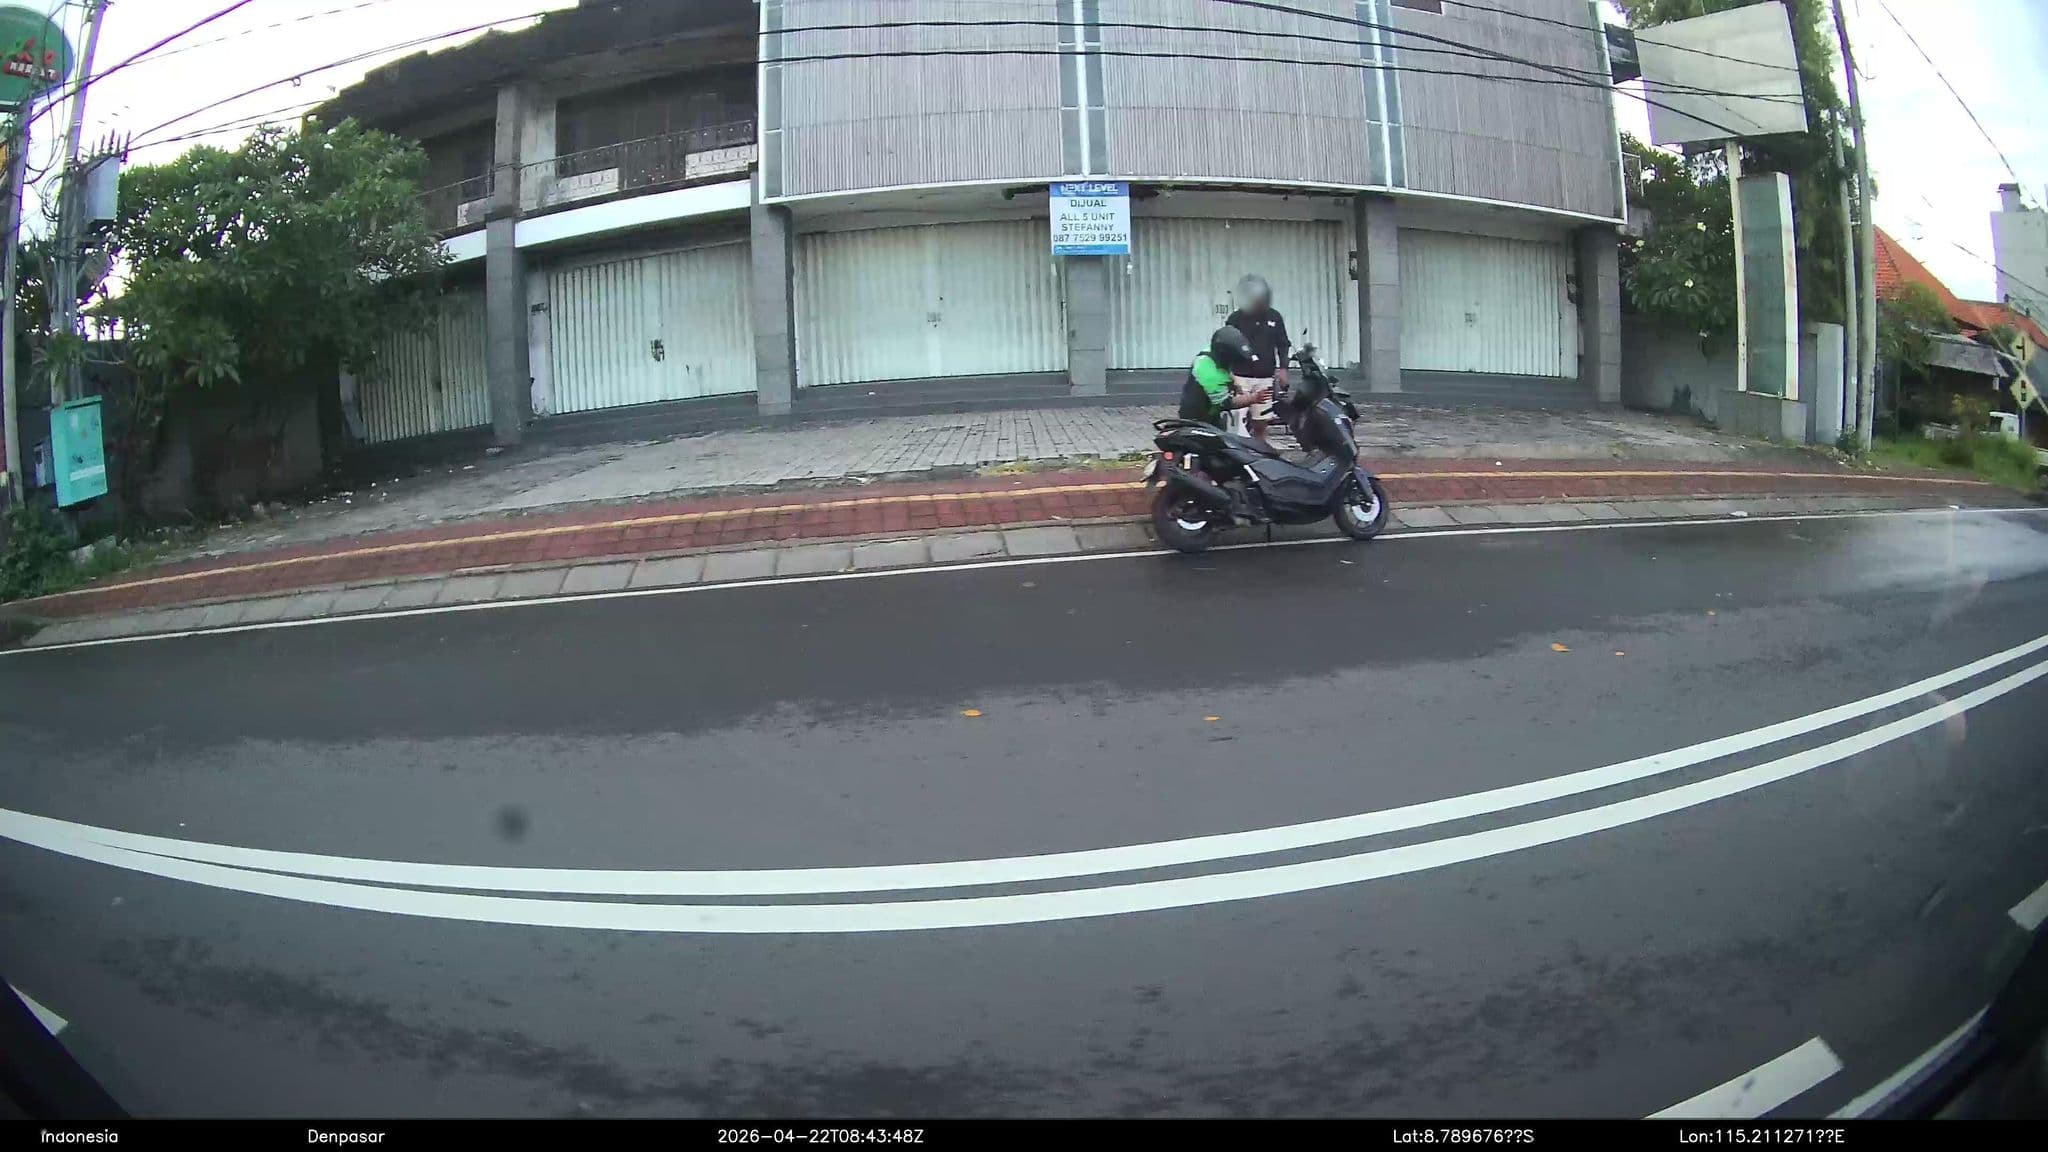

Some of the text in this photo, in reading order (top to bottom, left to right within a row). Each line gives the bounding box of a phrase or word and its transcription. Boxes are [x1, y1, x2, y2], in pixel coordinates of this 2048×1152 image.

[1089, 183, 1118, 192] LEVEL
[1070, 199, 1107, 208] DIJUAL
[1060, 212, 1115, 221] ALL 5 UNIT
[1061, 223, 1114, 231] STEFANNY
[1053, 233, 1127, 242] 087 7529 99251
